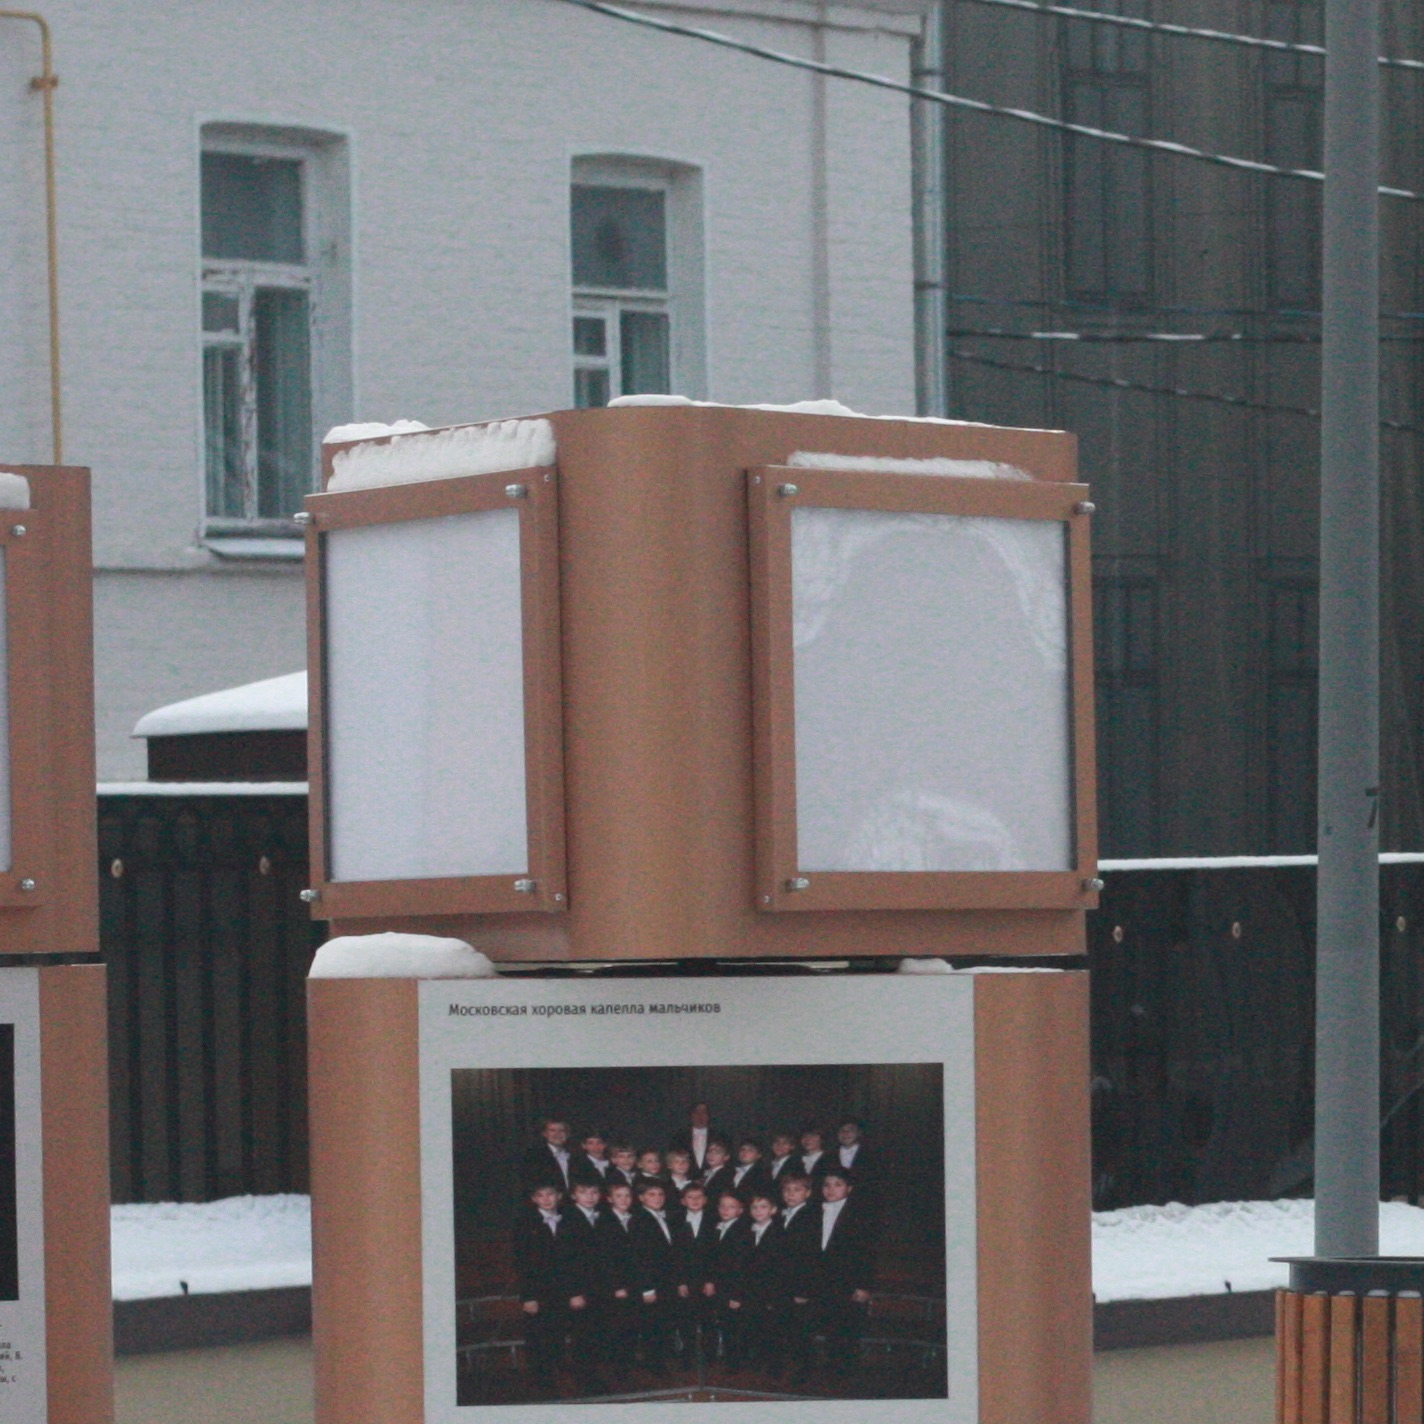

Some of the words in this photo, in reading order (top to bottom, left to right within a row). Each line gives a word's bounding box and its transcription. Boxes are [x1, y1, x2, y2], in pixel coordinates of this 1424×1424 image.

[448, 1003, 528, 1016] Московская
[531, 1004, 586, 1018] хоровая
[591, 1003, 645, 1015] капелла
[650, 1002, 722, 1014] мальчиков
